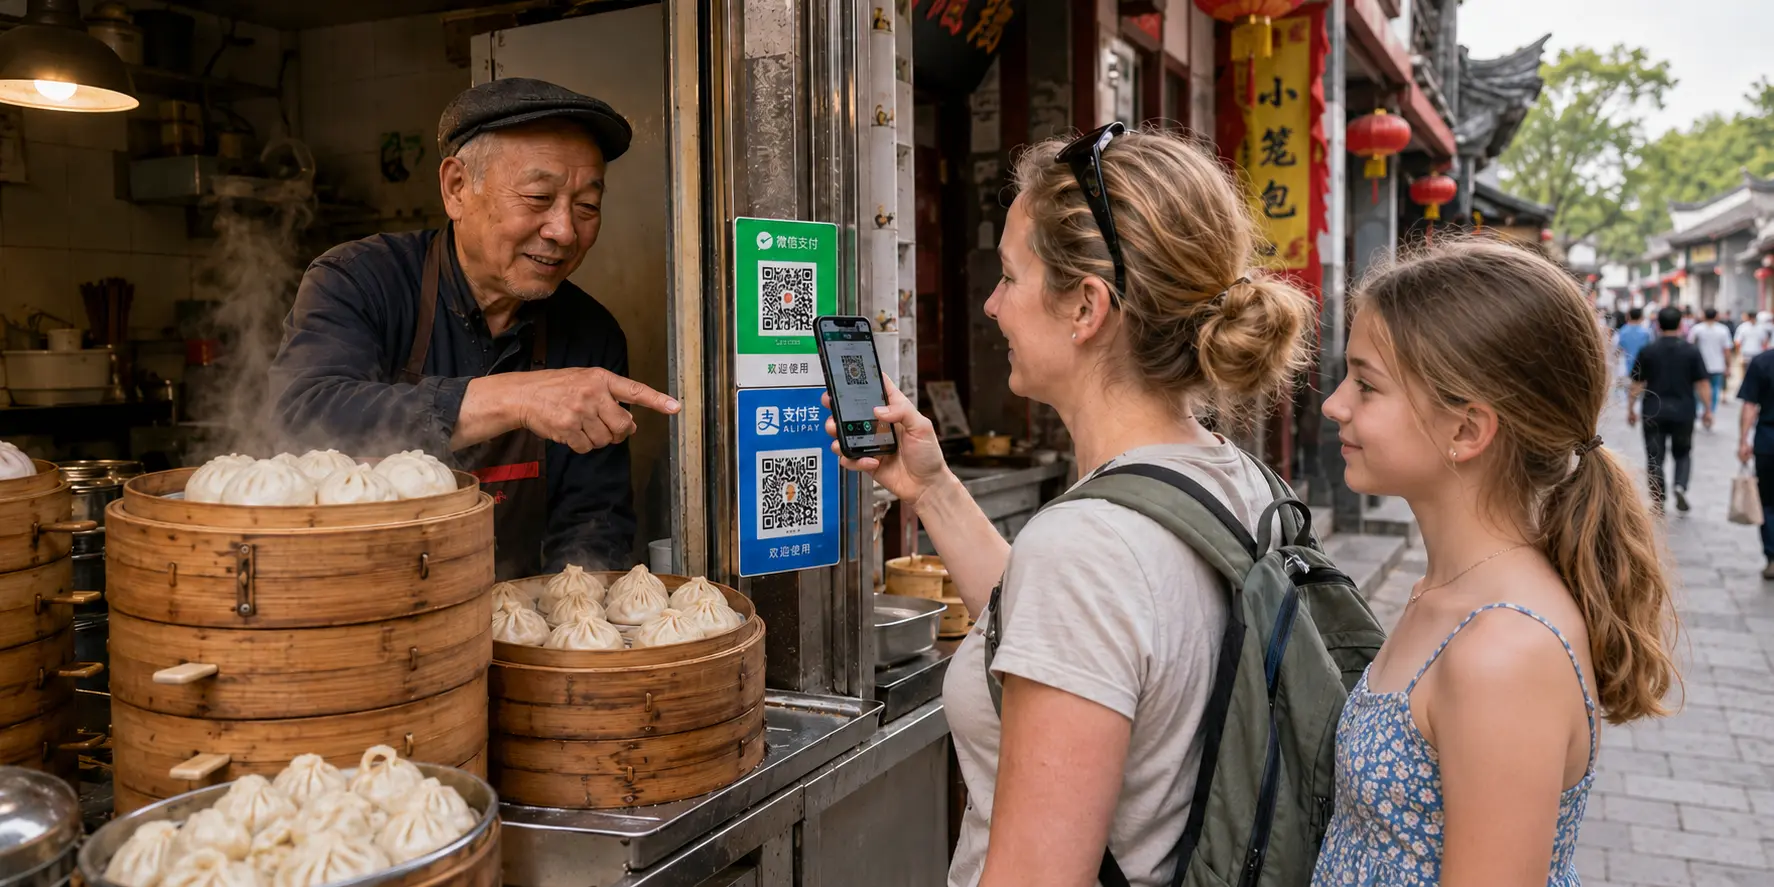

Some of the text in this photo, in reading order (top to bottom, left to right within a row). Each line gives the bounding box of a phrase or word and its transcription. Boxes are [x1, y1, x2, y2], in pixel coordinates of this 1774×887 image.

[1258, 76, 1298, 219] 小笼包
[776, 235, 818, 250] 微信支付
[767, 362, 808, 375] 欢迎使用
[783, 424, 820, 433] ALIPAY
[768, 543, 811, 559] 欢迎使用
